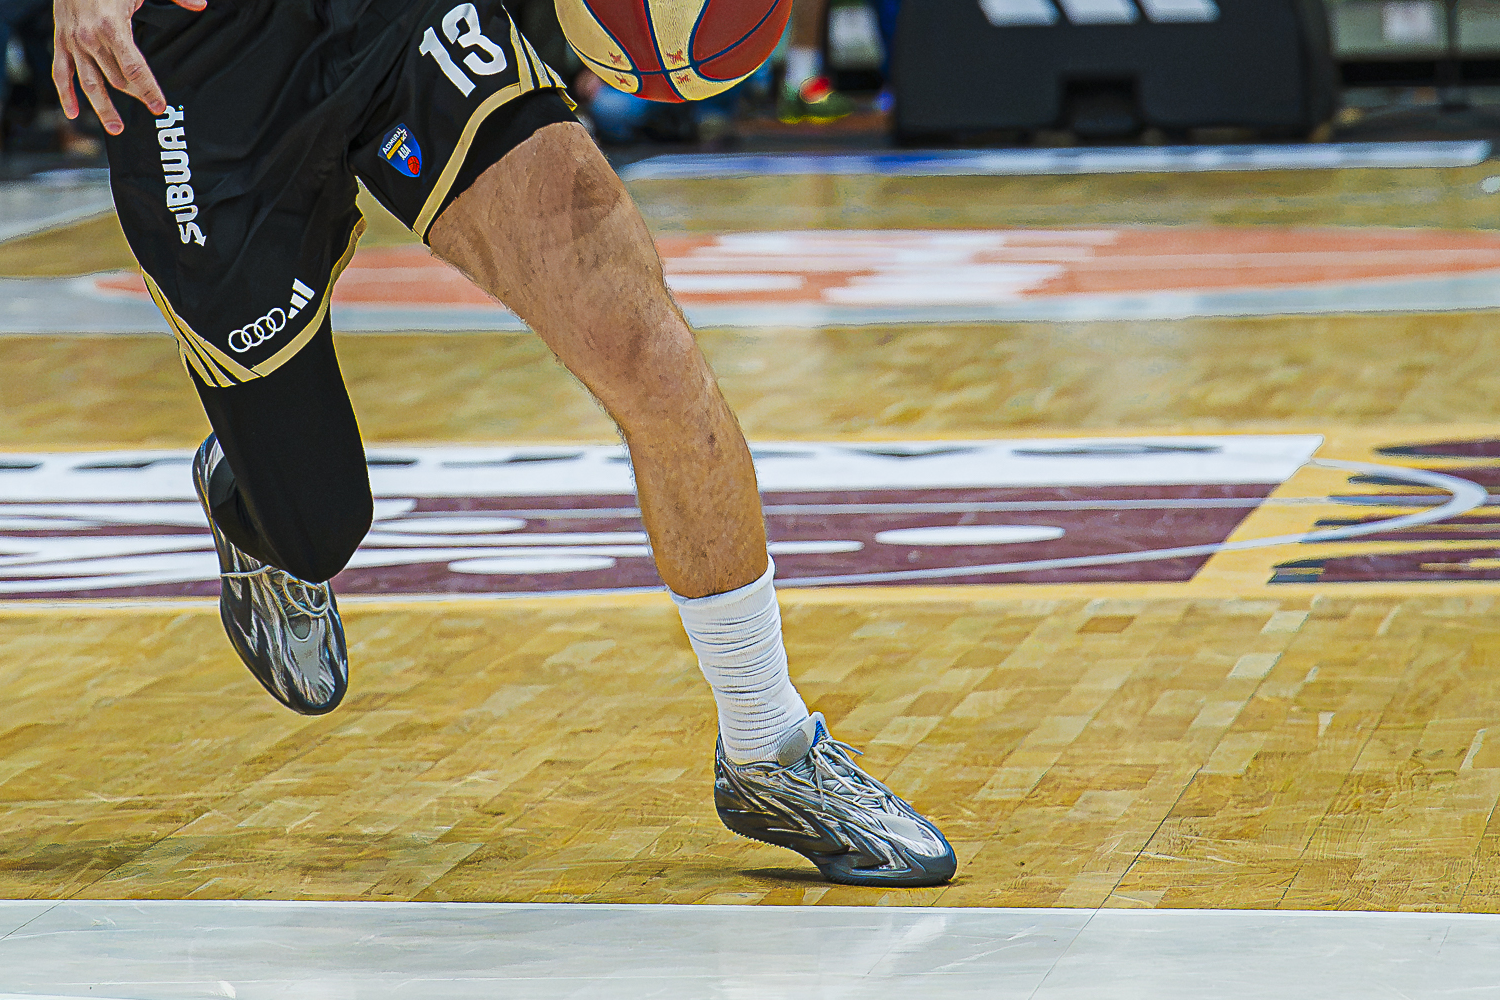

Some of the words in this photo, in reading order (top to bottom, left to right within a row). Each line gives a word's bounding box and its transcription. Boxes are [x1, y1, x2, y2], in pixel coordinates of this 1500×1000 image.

[418, 2, 508, 98] 13
[155, 105, 207, 247] SUBWAY
[382, 127, 404, 155] ADMIRAL
